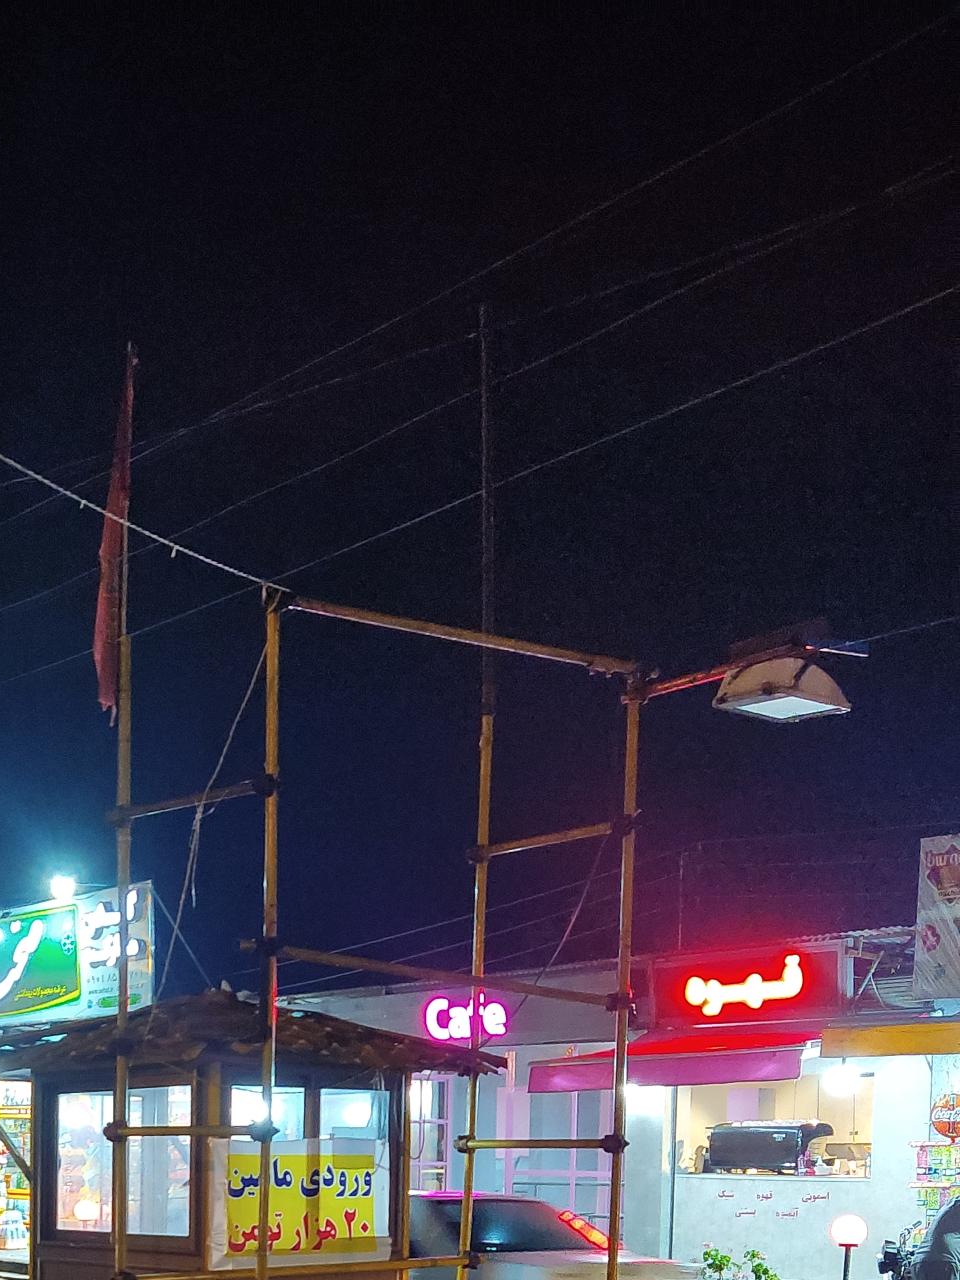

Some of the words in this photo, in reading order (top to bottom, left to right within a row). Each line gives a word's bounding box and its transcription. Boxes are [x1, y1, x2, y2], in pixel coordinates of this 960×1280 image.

[300, 1164, 372, 1197] ورودی
[289, 1211, 338, 1251] هزار
[343, 1208, 370, 1241] ۲۰
